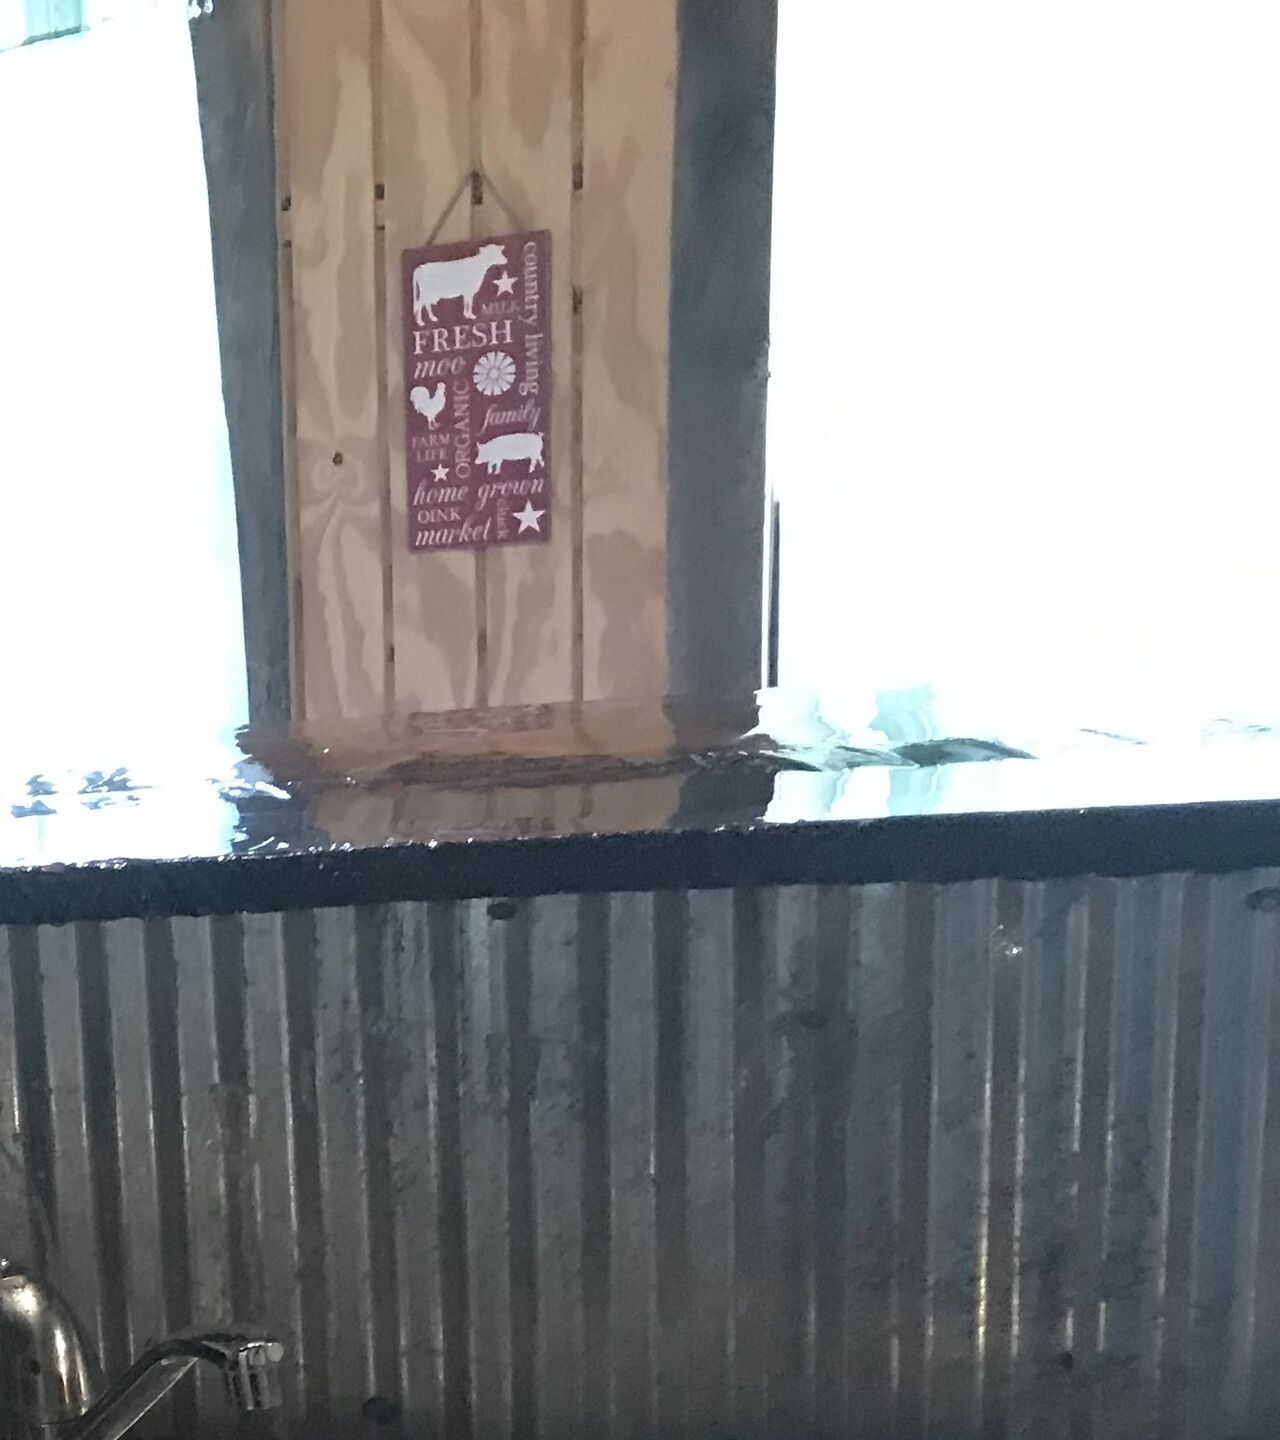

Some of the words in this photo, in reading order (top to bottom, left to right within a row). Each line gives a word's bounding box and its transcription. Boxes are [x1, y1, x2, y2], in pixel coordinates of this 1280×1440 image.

[517, 241, 540, 327] country
[412, 319, 514, 355] FRESH
[414, 355, 467, 380] moo
[519, 333, 544, 396] living
[453, 379, 471, 479] ORGANIC
[475, 398, 542, 437] family
[412, 432, 450, 449] FARM
[416, 447, 448, 463] LIFE
[413, 478, 469, 506] home
[475, 478, 545, 512] grown
[415, 512, 492, 547] market
[417, 507, 461, 524] OINK
